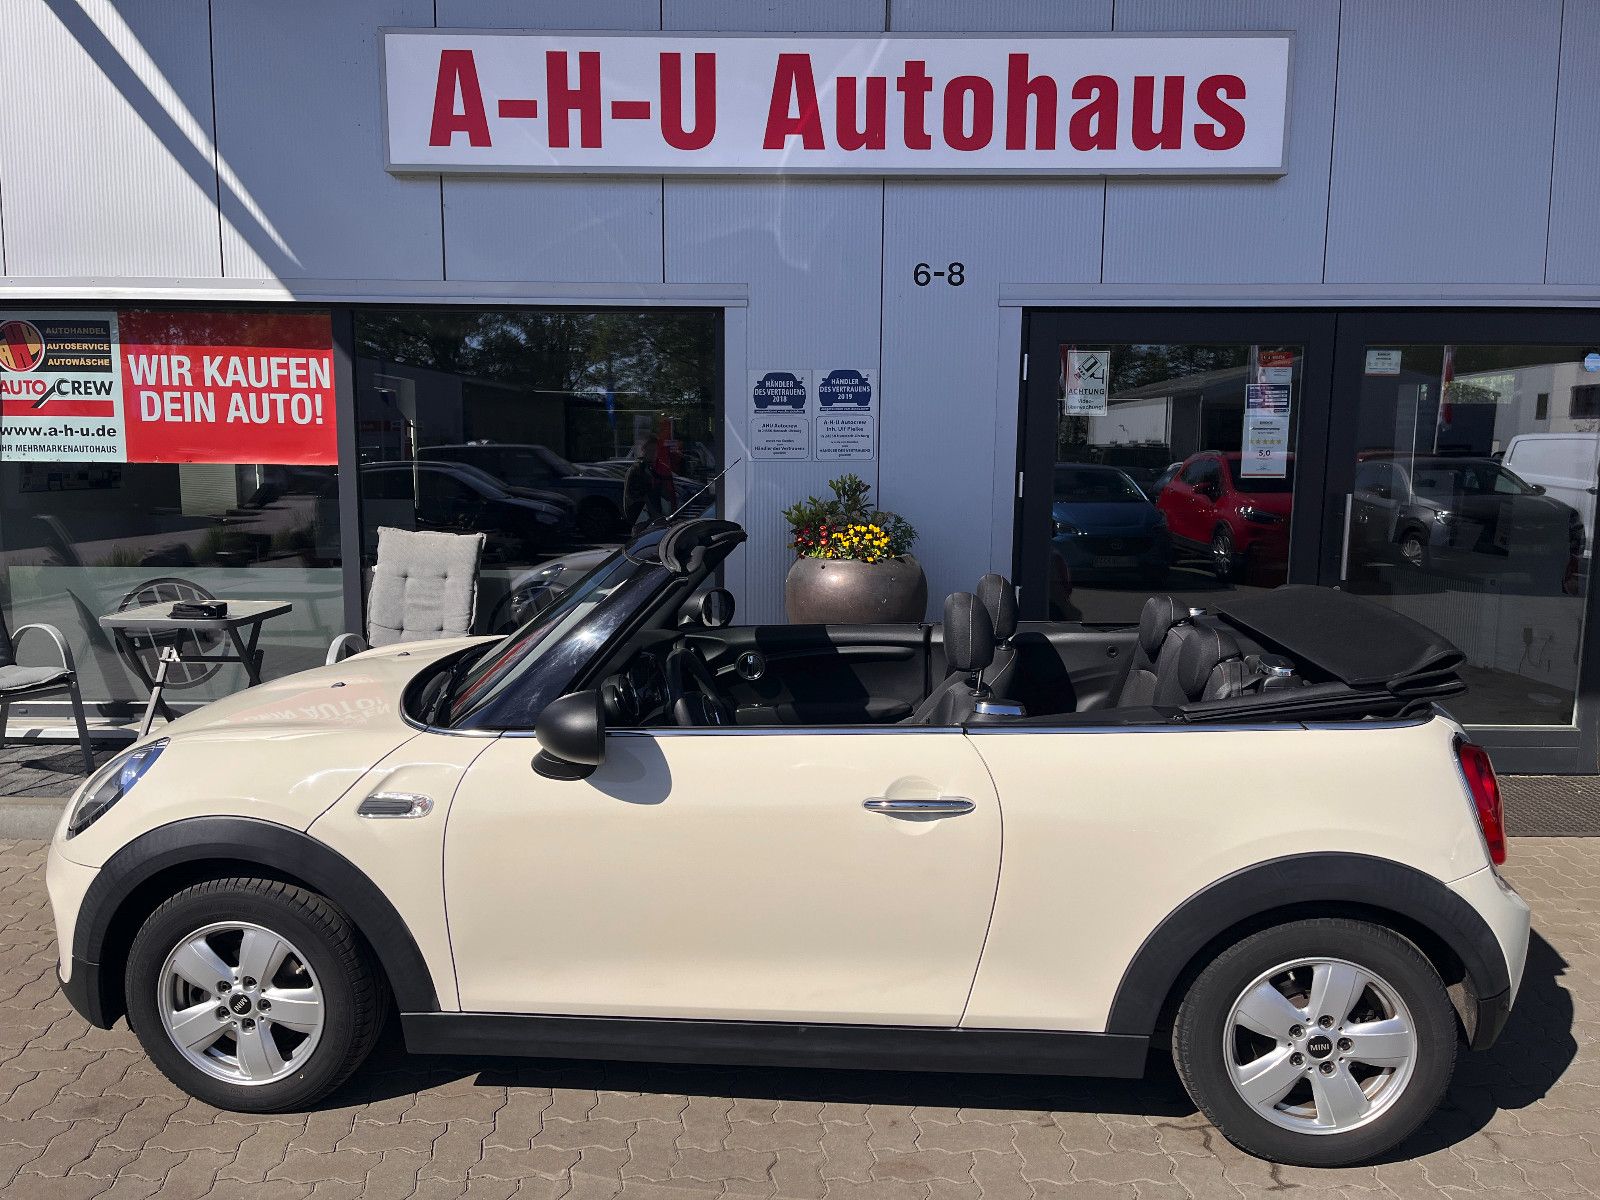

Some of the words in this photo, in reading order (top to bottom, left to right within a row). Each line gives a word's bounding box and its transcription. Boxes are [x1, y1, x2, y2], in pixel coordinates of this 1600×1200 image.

[429, 49, 717, 151] A-H-U
[763, 53, 1247, 151] Autohaus
[912, 261, 966, 288] 6-8
[46, 327, 106, 335] AUTOHANDEL
[46, 343, 110, 351] AUTOSERVICE
[47, 357, 110, 366] AUTOWÄSCHE
[127, 354, 193, 387] WIR
[204, 355, 331, 390] KAUFEN
[765, 379, 794, 388] HÄNDLER
[831, 377, 859, 385] HÄNDLER
[754, 388, 766, 396] DES
[767, 388, 805, 396] VERTRAUENS
[819, 385, 831, 393] DES
[832, 385, 871, 393] VERTRAUENS
[140, 391, 216, 423] DEIN
[226, 392, 324, 425] AUTO!
[0, 424, 117, 437] www.a-h-u.de
[15, 444, 117, 454] MEHRMARKENAUTOHAUS
[1258, 449, 1271, 458] 5,0
[1309, 1043, 1330, 1051] MINI
